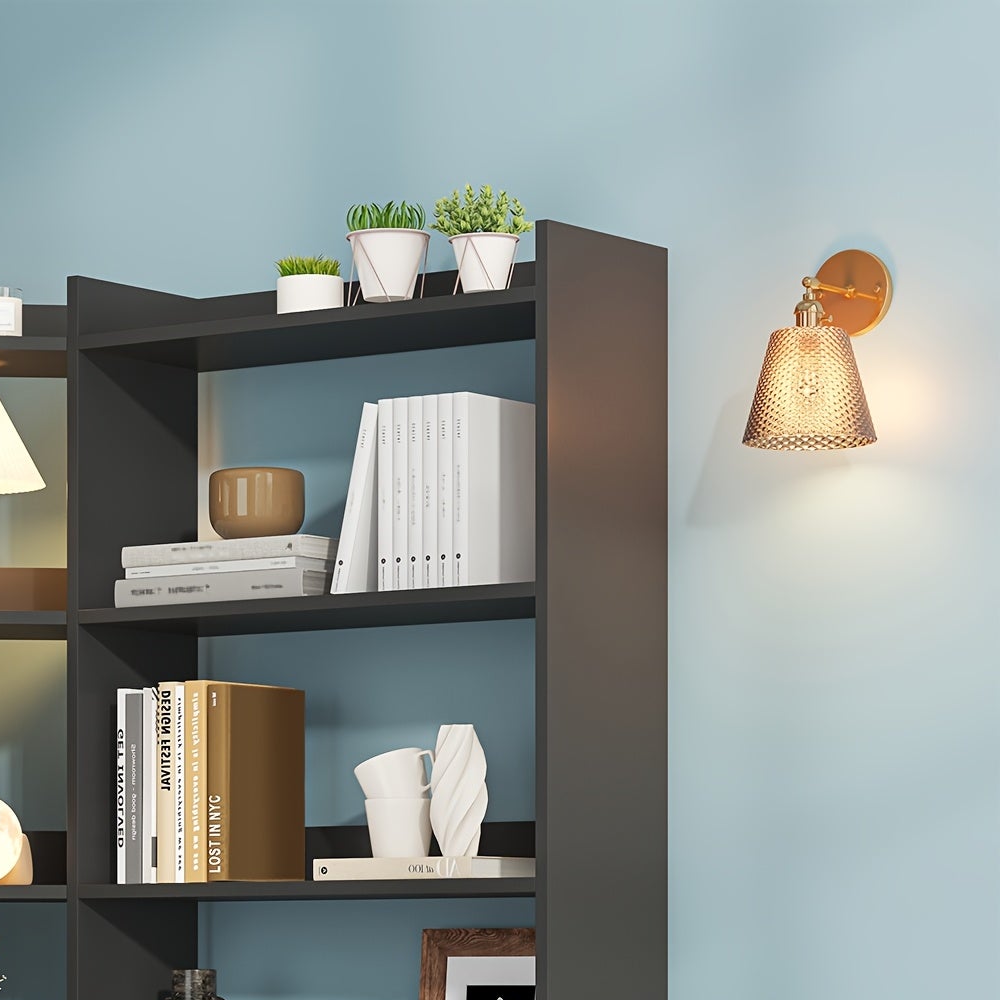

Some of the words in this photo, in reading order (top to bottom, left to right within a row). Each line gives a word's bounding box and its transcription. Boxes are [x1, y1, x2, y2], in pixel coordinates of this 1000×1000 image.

[208, 795, 221, 820] NYC
[208, 824, 221, 837] IN
[208, 840, 221, 873] LOST
